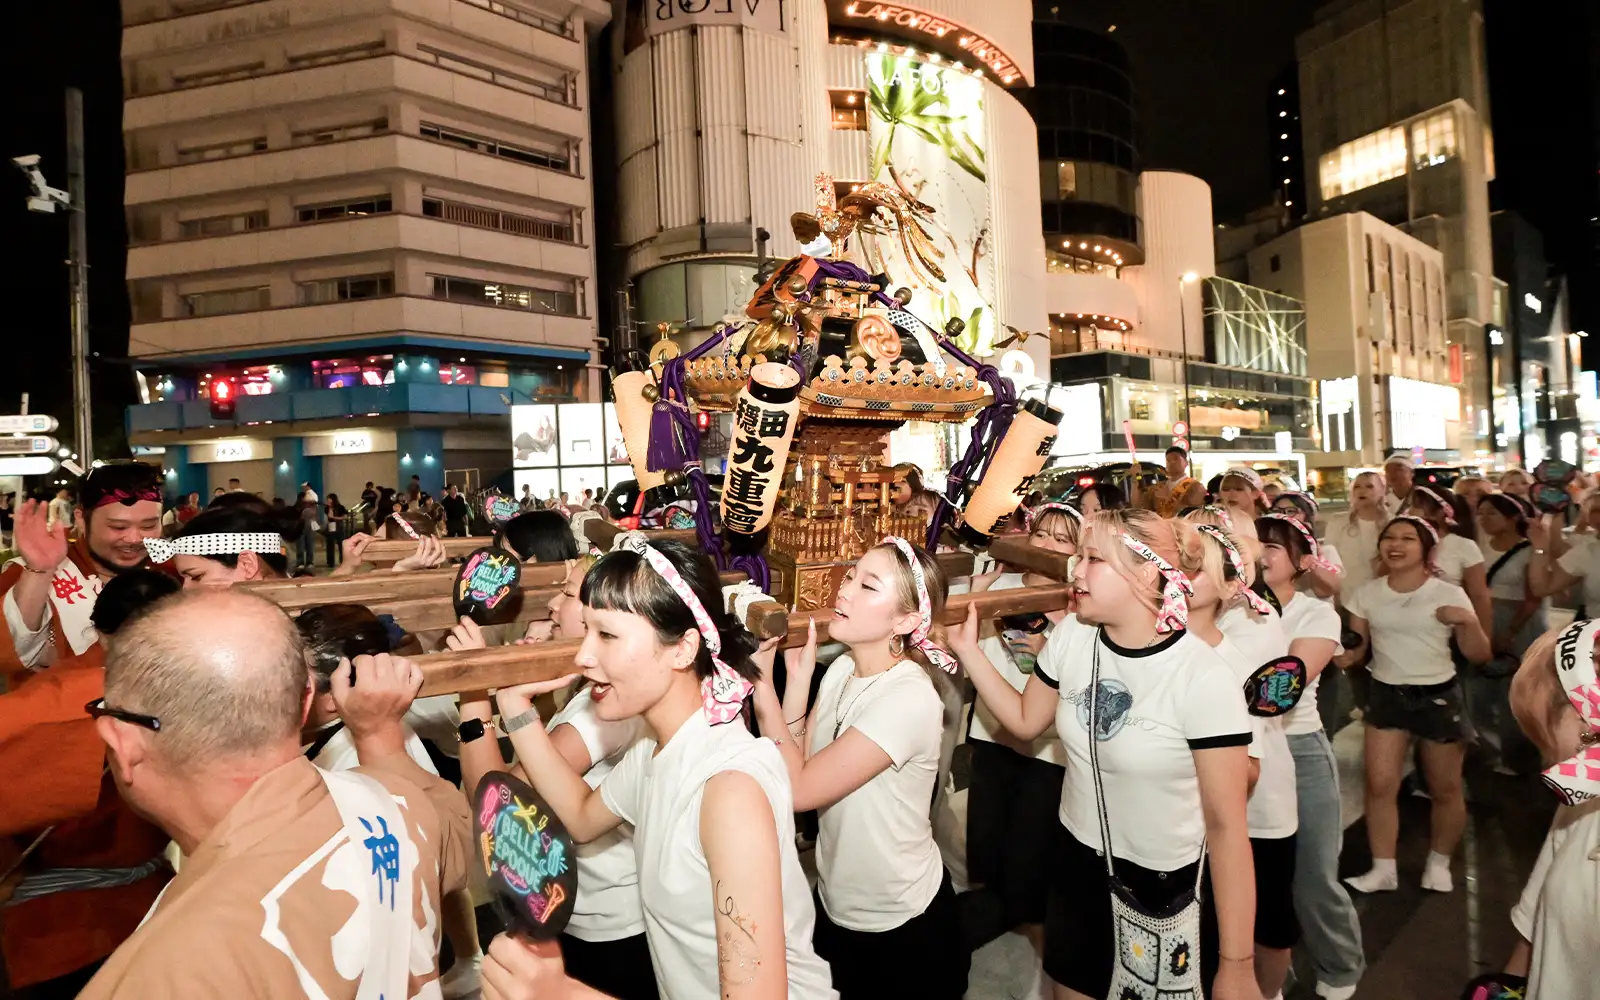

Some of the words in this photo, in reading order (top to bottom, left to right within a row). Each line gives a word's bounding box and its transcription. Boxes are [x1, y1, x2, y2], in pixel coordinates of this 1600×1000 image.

[849, 1, 959, 37] LAFORET
[964, 35, 1022, 81] MUSEUM
[477, 564, 502, 583] BELLE
[501, 813, 541, 864] BELLE
